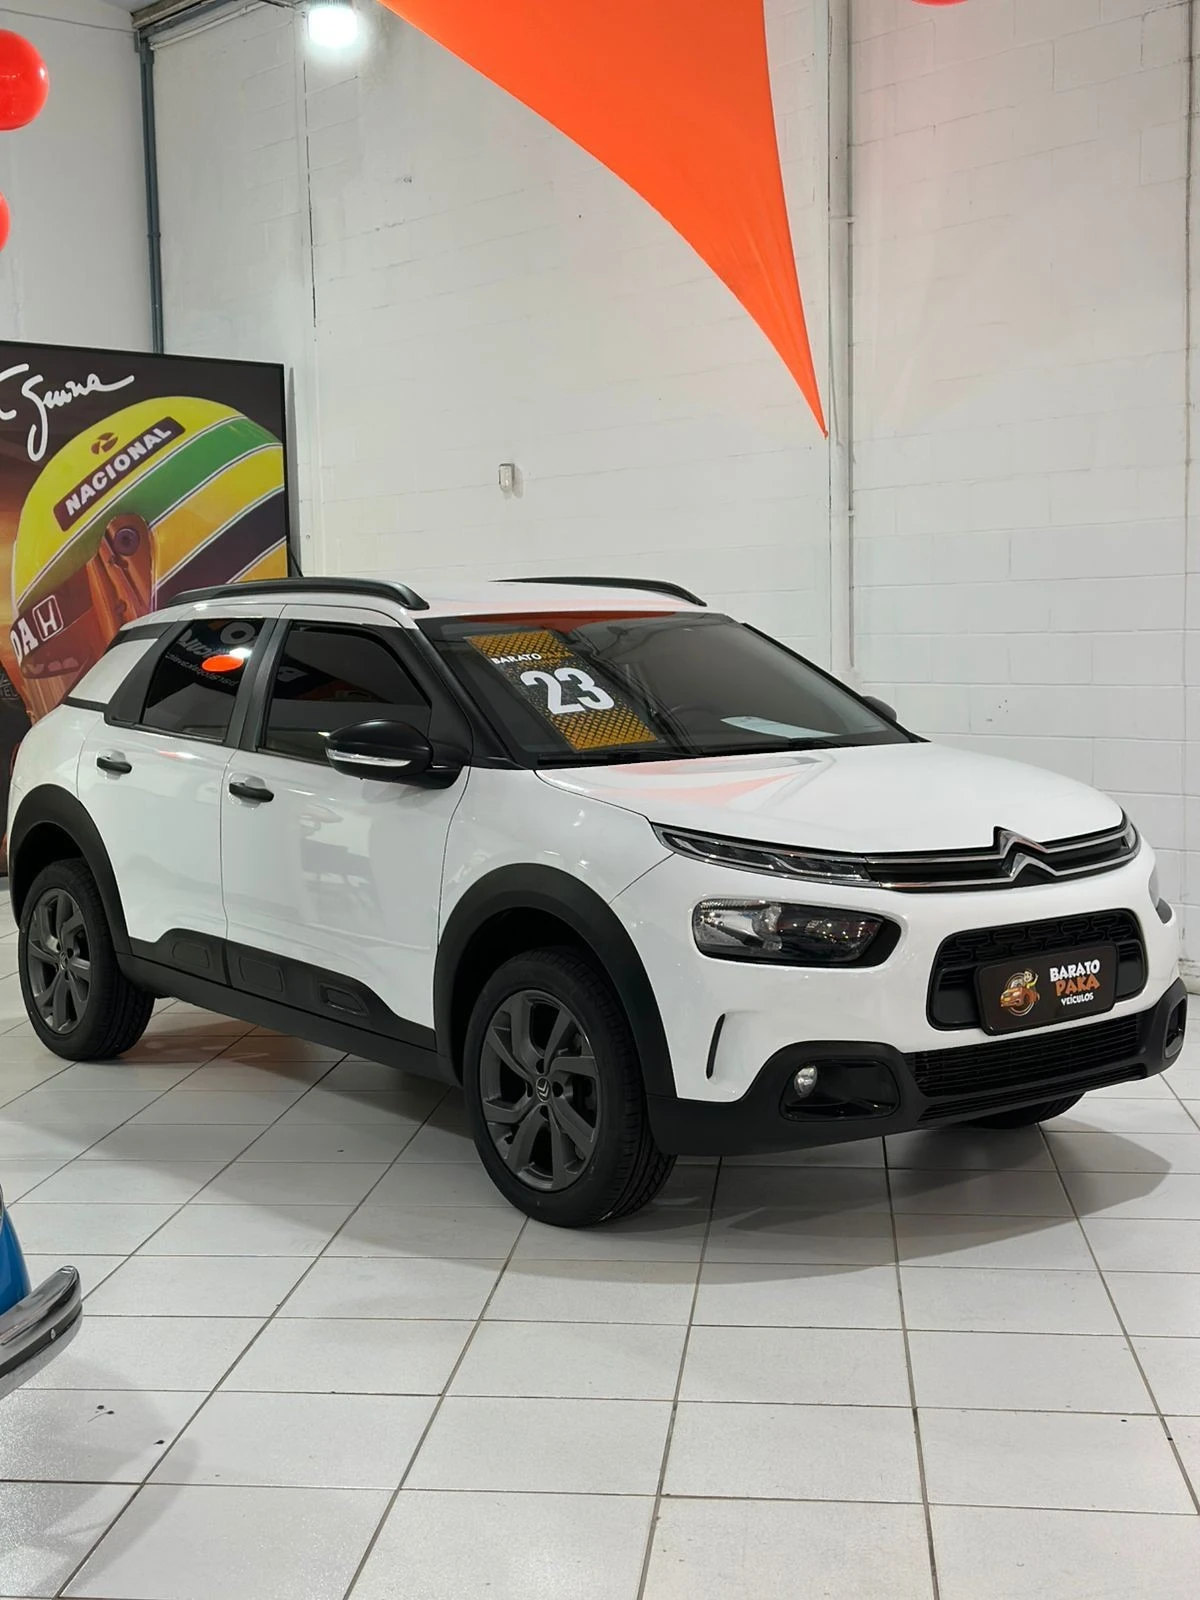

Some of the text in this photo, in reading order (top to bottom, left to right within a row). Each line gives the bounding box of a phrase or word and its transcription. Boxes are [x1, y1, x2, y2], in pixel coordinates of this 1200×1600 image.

[65, 427, 172, 516] NACIONAL
[491, 652, 542, 665] BARATO
[520, 667, 615, 715] 23
[1050, 959, 1101, 982] BARATO
[1055, 974, 1101, 996] PAKA
[1061, 992, 1095, 1006] VEÍCULOS
